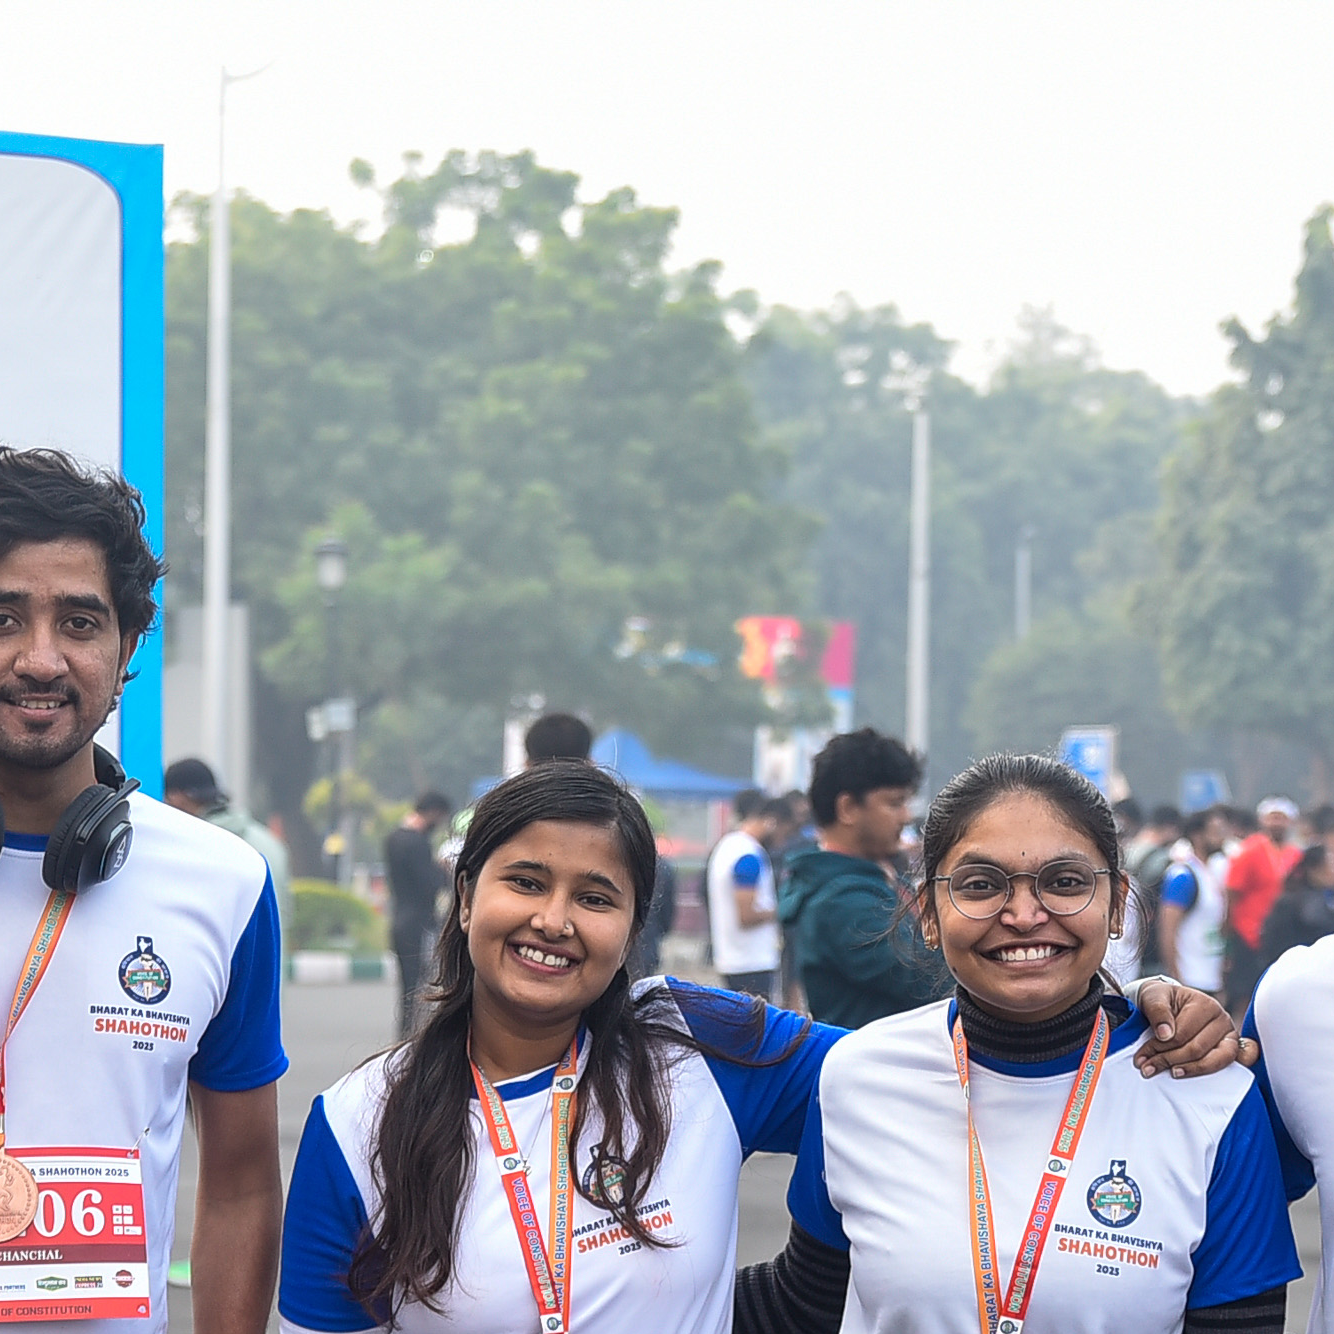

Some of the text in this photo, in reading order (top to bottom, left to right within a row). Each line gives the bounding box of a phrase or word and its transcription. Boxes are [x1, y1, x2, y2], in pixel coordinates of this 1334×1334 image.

[90, 1005, 190, 1026] BHARAT KA BHAVISHYA
[95, 1018, 187, 1042] SHAHOTHON
[132, 1041, 154, 1051] 2025
[1067, 1063, 1095, 1128] SHAHOTHON
[556, 1122, 568, 1190] SHAHOTHON
[39, 1167, 129, 1177] SHAHOTHON 2025
[512, 1177, 530, 1211] VOICE
[522, 1212, 535, 1227] OF
[555, 1192, 567, 1261] BHAVISHAYA
[975, 1203, 992, 1270] BHAVISHAYA
[1054, 1223, 1163, 1251] BHARAT KA BHAVISHYA
[618, 1241, 642, 1255] 2025
[1008, 1181, 1057, 1313] VOICE OF CONSTITUTION
[1058, 1237, 1159, 1269] SHAHOTHON
[554, 1263, 564, 1278] KA
[982, 1272, 994, 1289] KA
[1096, 1264, 1120, 1277] 2025
[1, 1308, 13, 1317] OF
[15, 1305, 92, 1316] CONSTITUTION
